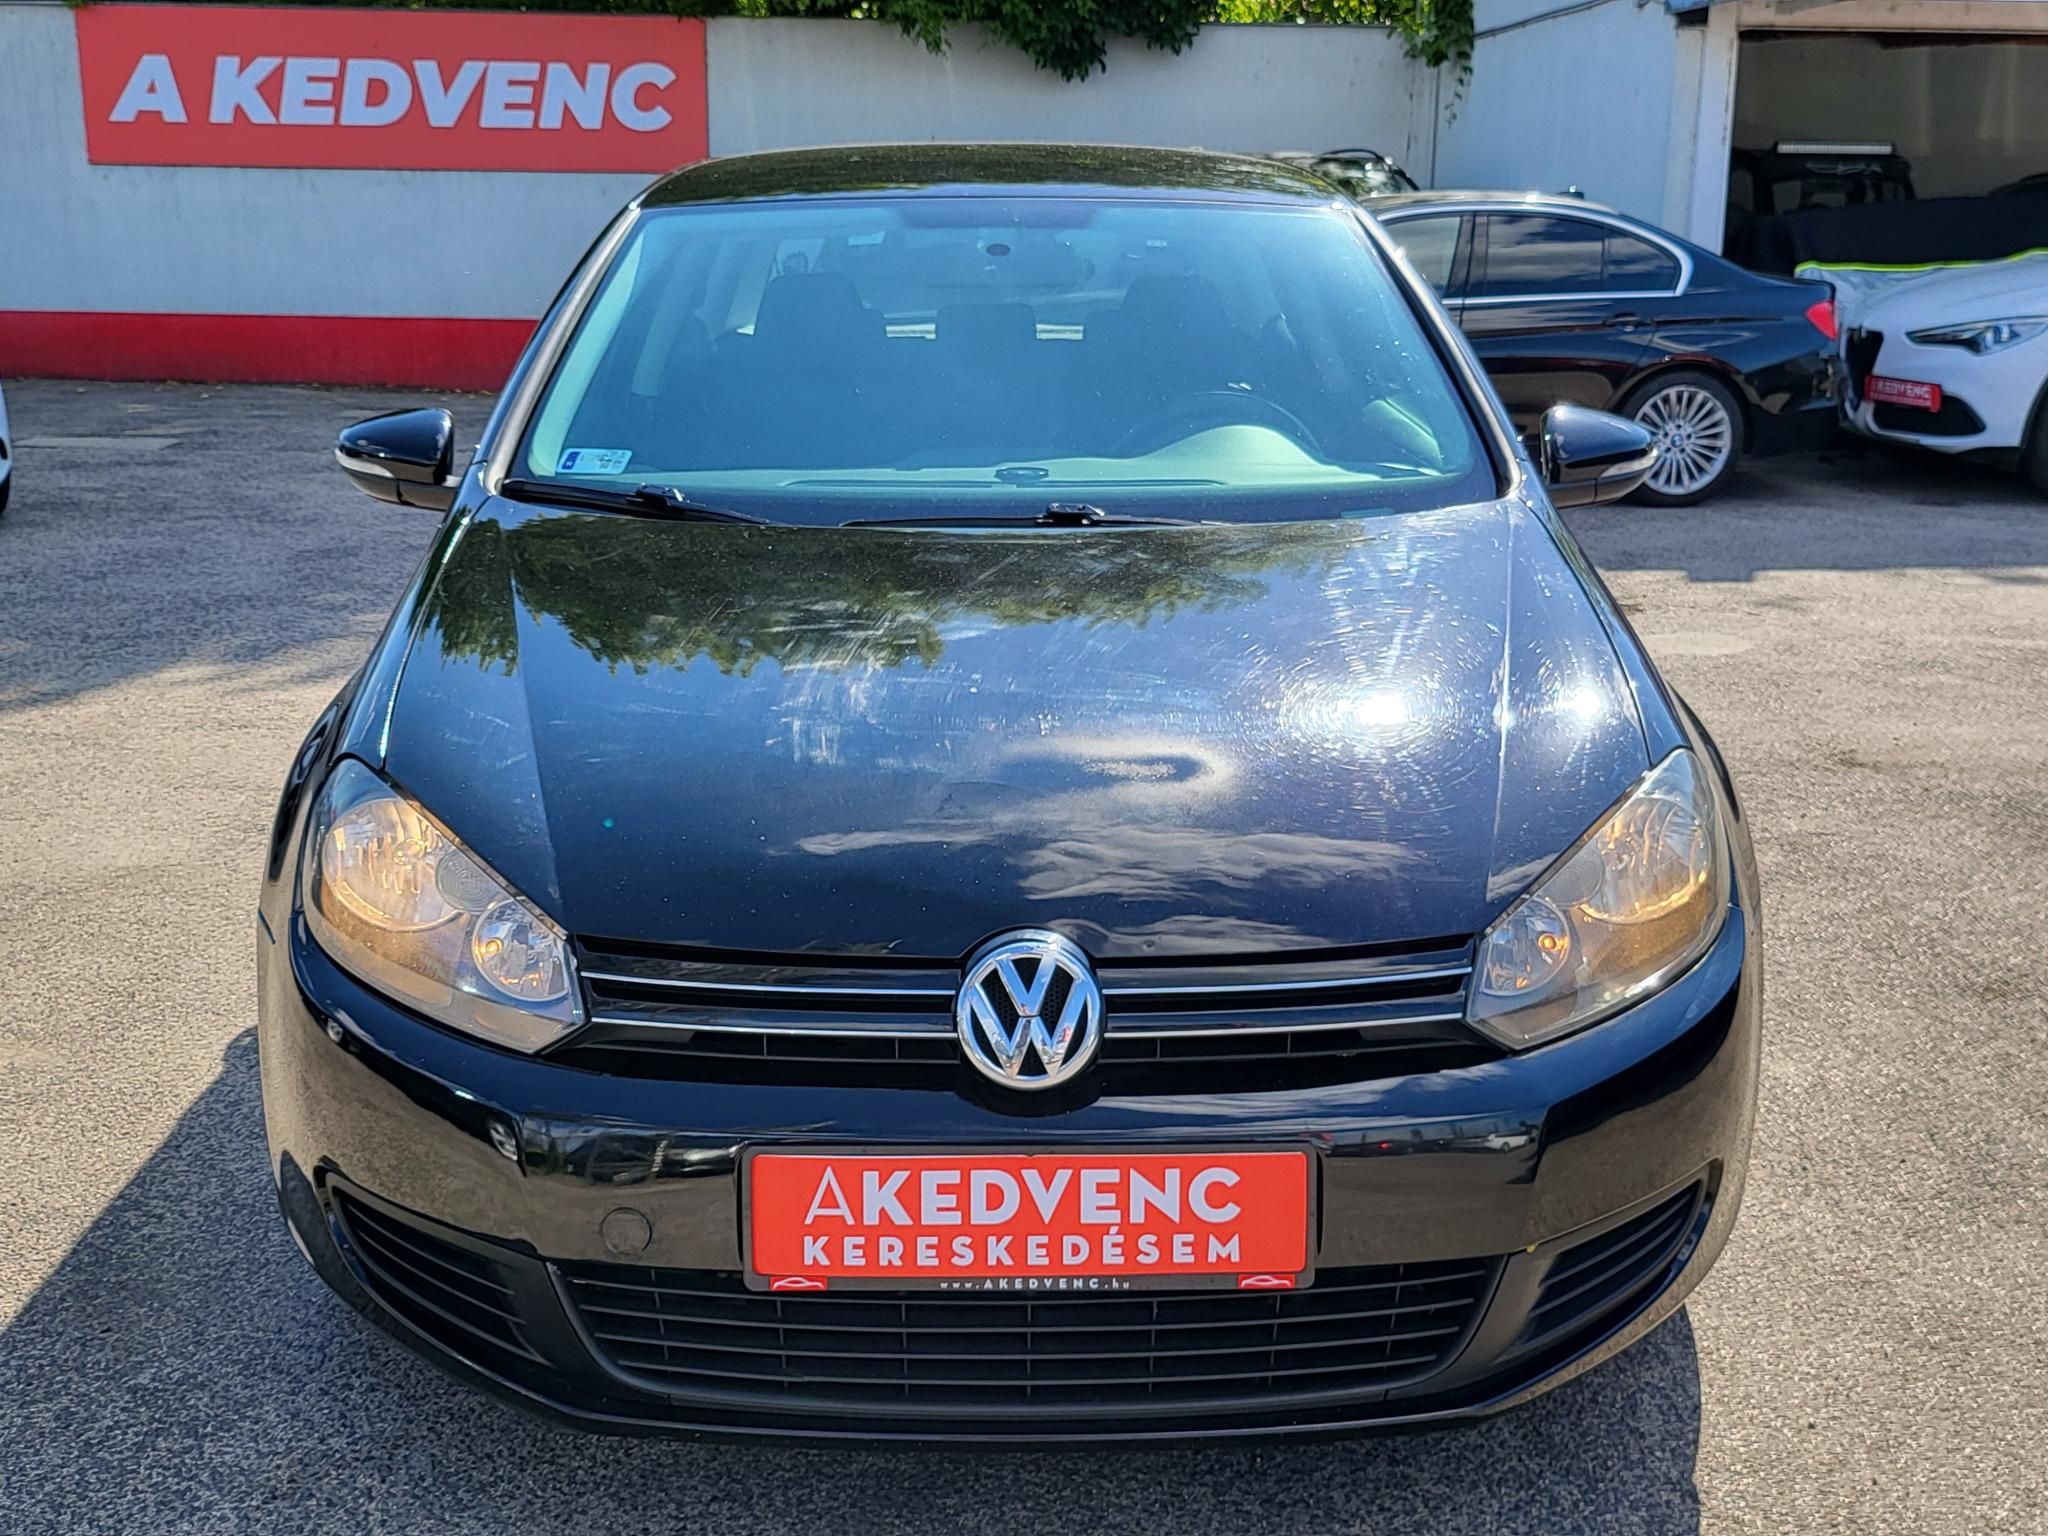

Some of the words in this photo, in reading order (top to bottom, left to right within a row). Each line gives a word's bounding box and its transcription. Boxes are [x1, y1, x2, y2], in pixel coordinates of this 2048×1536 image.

[109, 54, 188, 123] A
[209, 56, 678, 132] KEDVENC
[803, 1227, 1240, 1267] KERESKEDÉSEM
[940, 1277, 1130, 1290] www.AKEDVENC.hu
